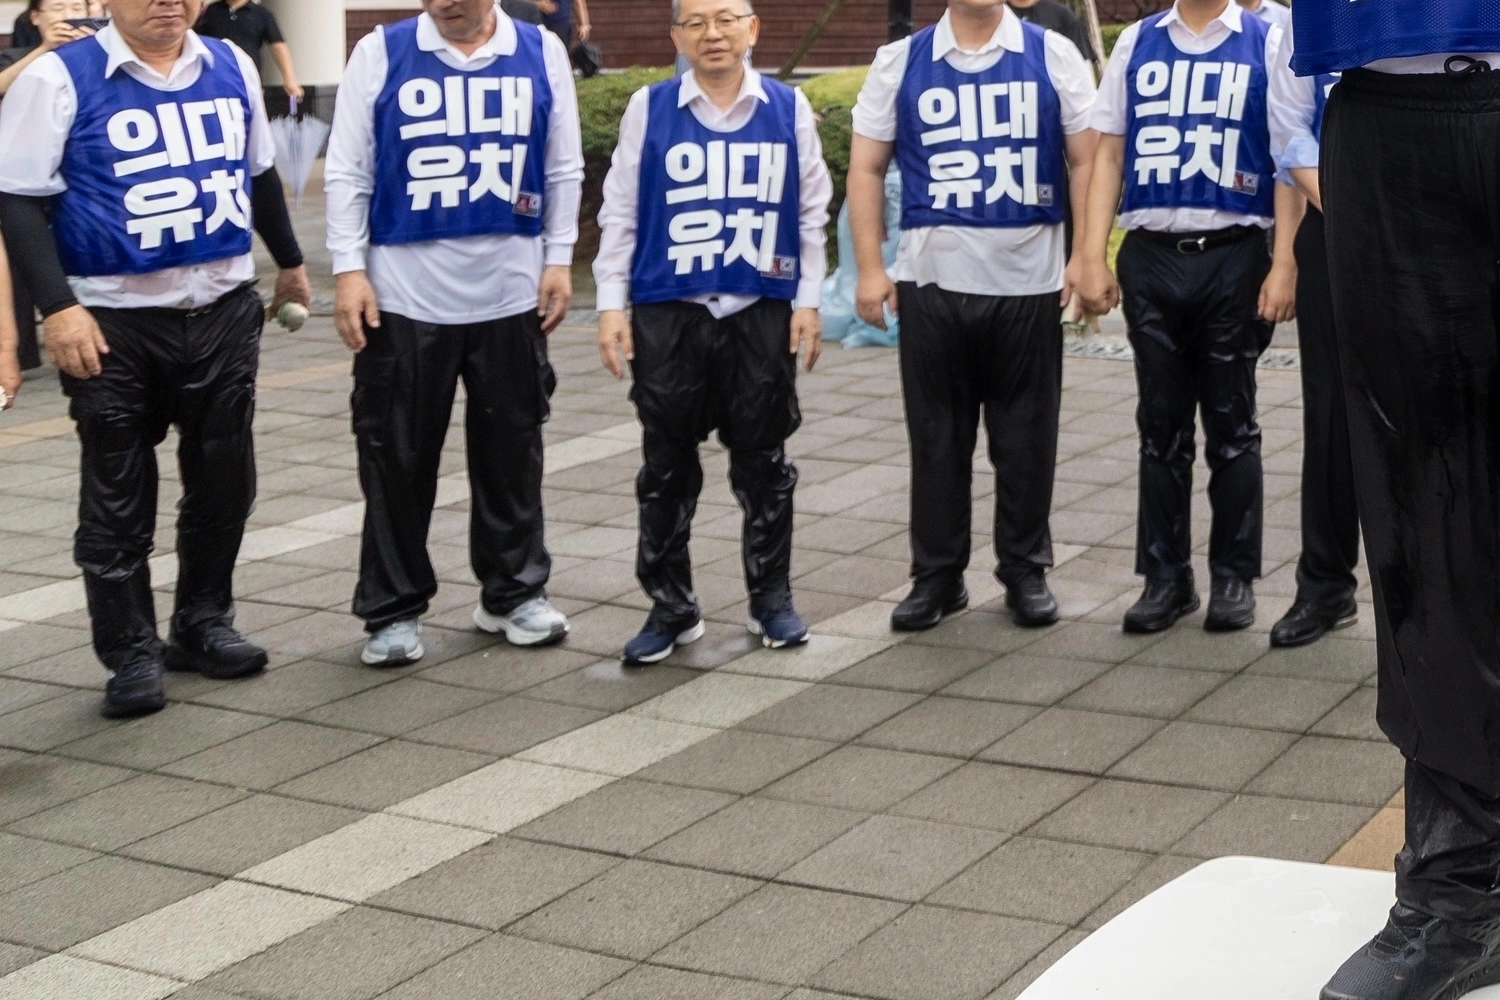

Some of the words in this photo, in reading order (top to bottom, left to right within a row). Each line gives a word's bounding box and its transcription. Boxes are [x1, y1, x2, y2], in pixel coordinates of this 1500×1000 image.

[399, 76, 533, 139] 의대
[918, 81, 1038, 146] 의대
[1135, 60, 1251, 121] 의대
[107, 97, 247, 177] 의대
[1135, 125, 1241, 189] 유치
[406, 143, 528, 210] 유치
[665, 141, 788, 204] 의대
[928, 147, 1039, 209] 유치
[124, 167, 252, 250] 유치
[668, 209, 779, 274] 유치
